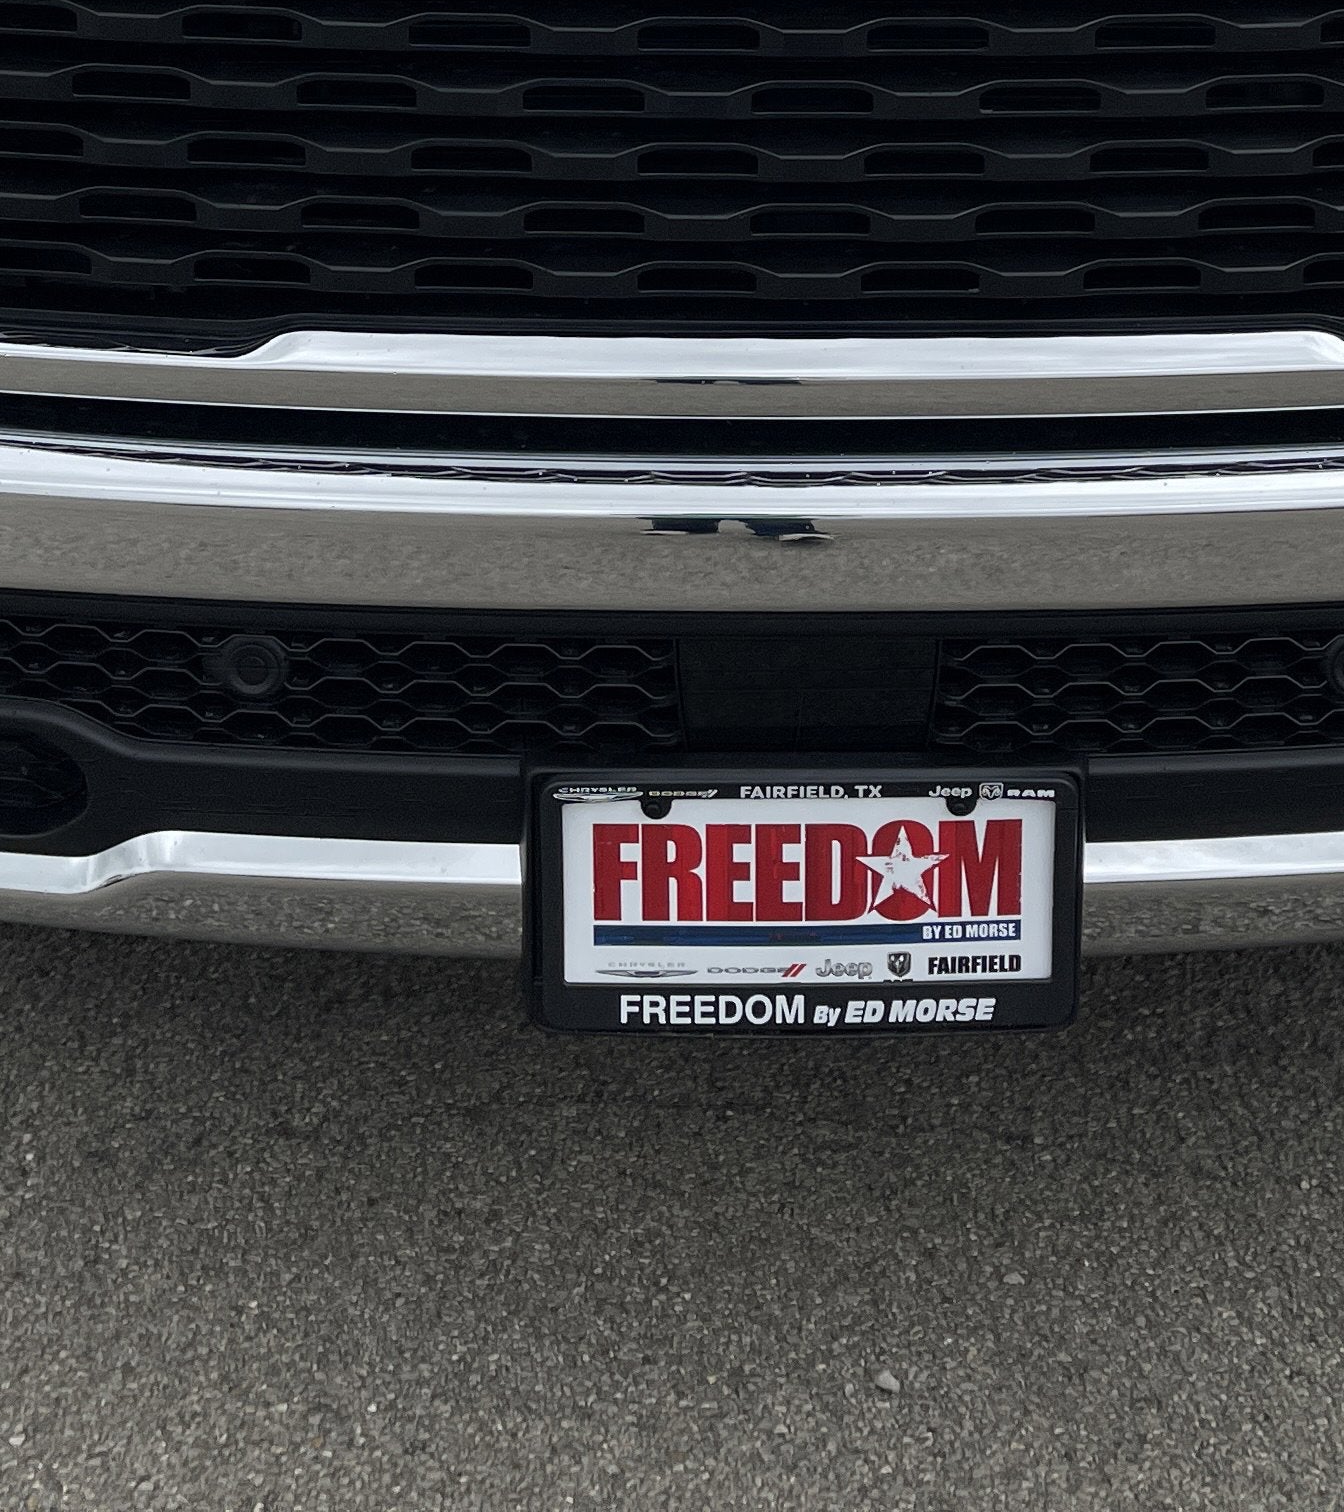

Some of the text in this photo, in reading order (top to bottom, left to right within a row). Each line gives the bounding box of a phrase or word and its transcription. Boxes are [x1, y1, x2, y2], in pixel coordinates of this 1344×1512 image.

[740, 784, 882, 799] FAIRFIELD, TX
[929, 785, 973, 799] Jeep
[1007, 789, 1055, 798] RAM
[593, 819, 1022, 922] FREEDOM
[922, 923, 1016, 939] BY ED MORSE
[707, 966, 787, 974] DODGE
[815, 959, 873, 979] Jeep
[927, 954, 1022, 975] FAIRFIELD
[620, 994, 996, 1026] FREEDOM By ED MORSE
